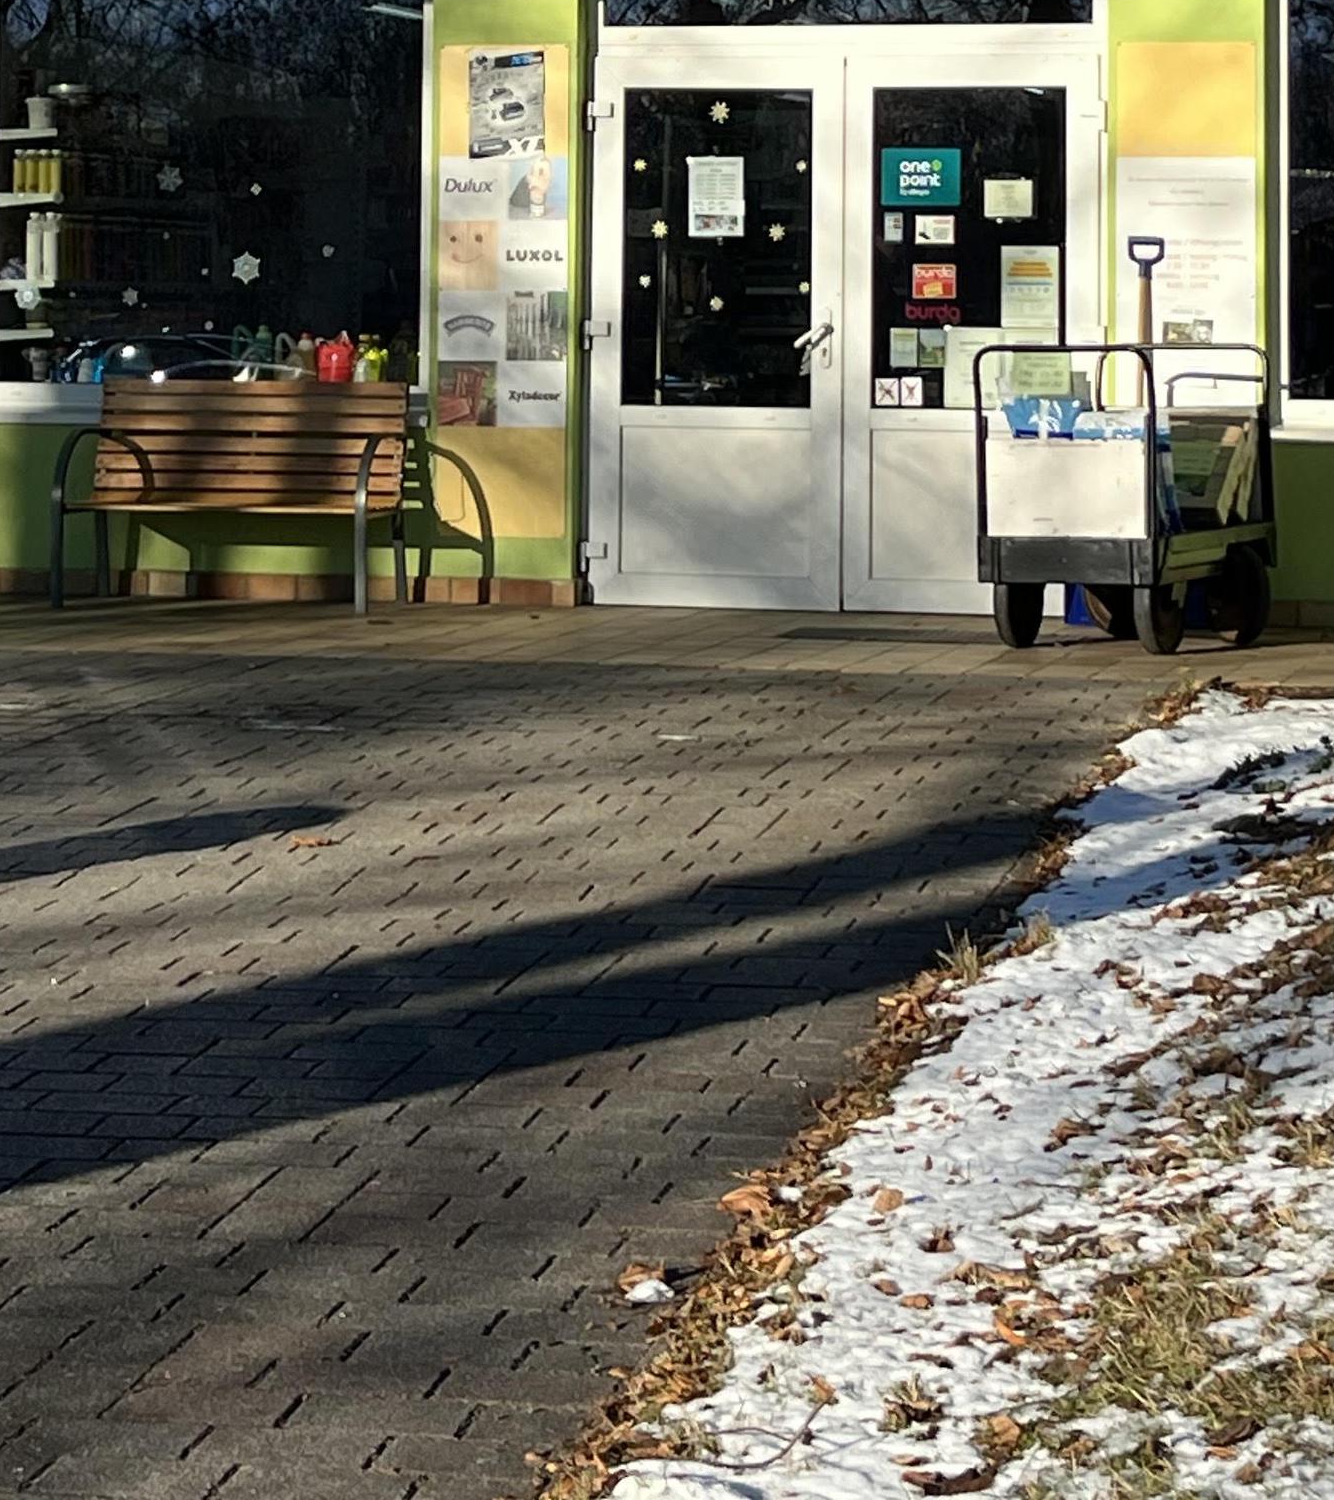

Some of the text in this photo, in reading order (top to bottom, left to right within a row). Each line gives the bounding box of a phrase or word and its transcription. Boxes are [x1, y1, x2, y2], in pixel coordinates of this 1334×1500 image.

[899, 161, 931, 173] one
[444, 178, 493, 193] Dulux
[899, 173, 942, 188] point
[506, 249, 564, 262] LUXOL
[905, 302, 961, 324] burda
